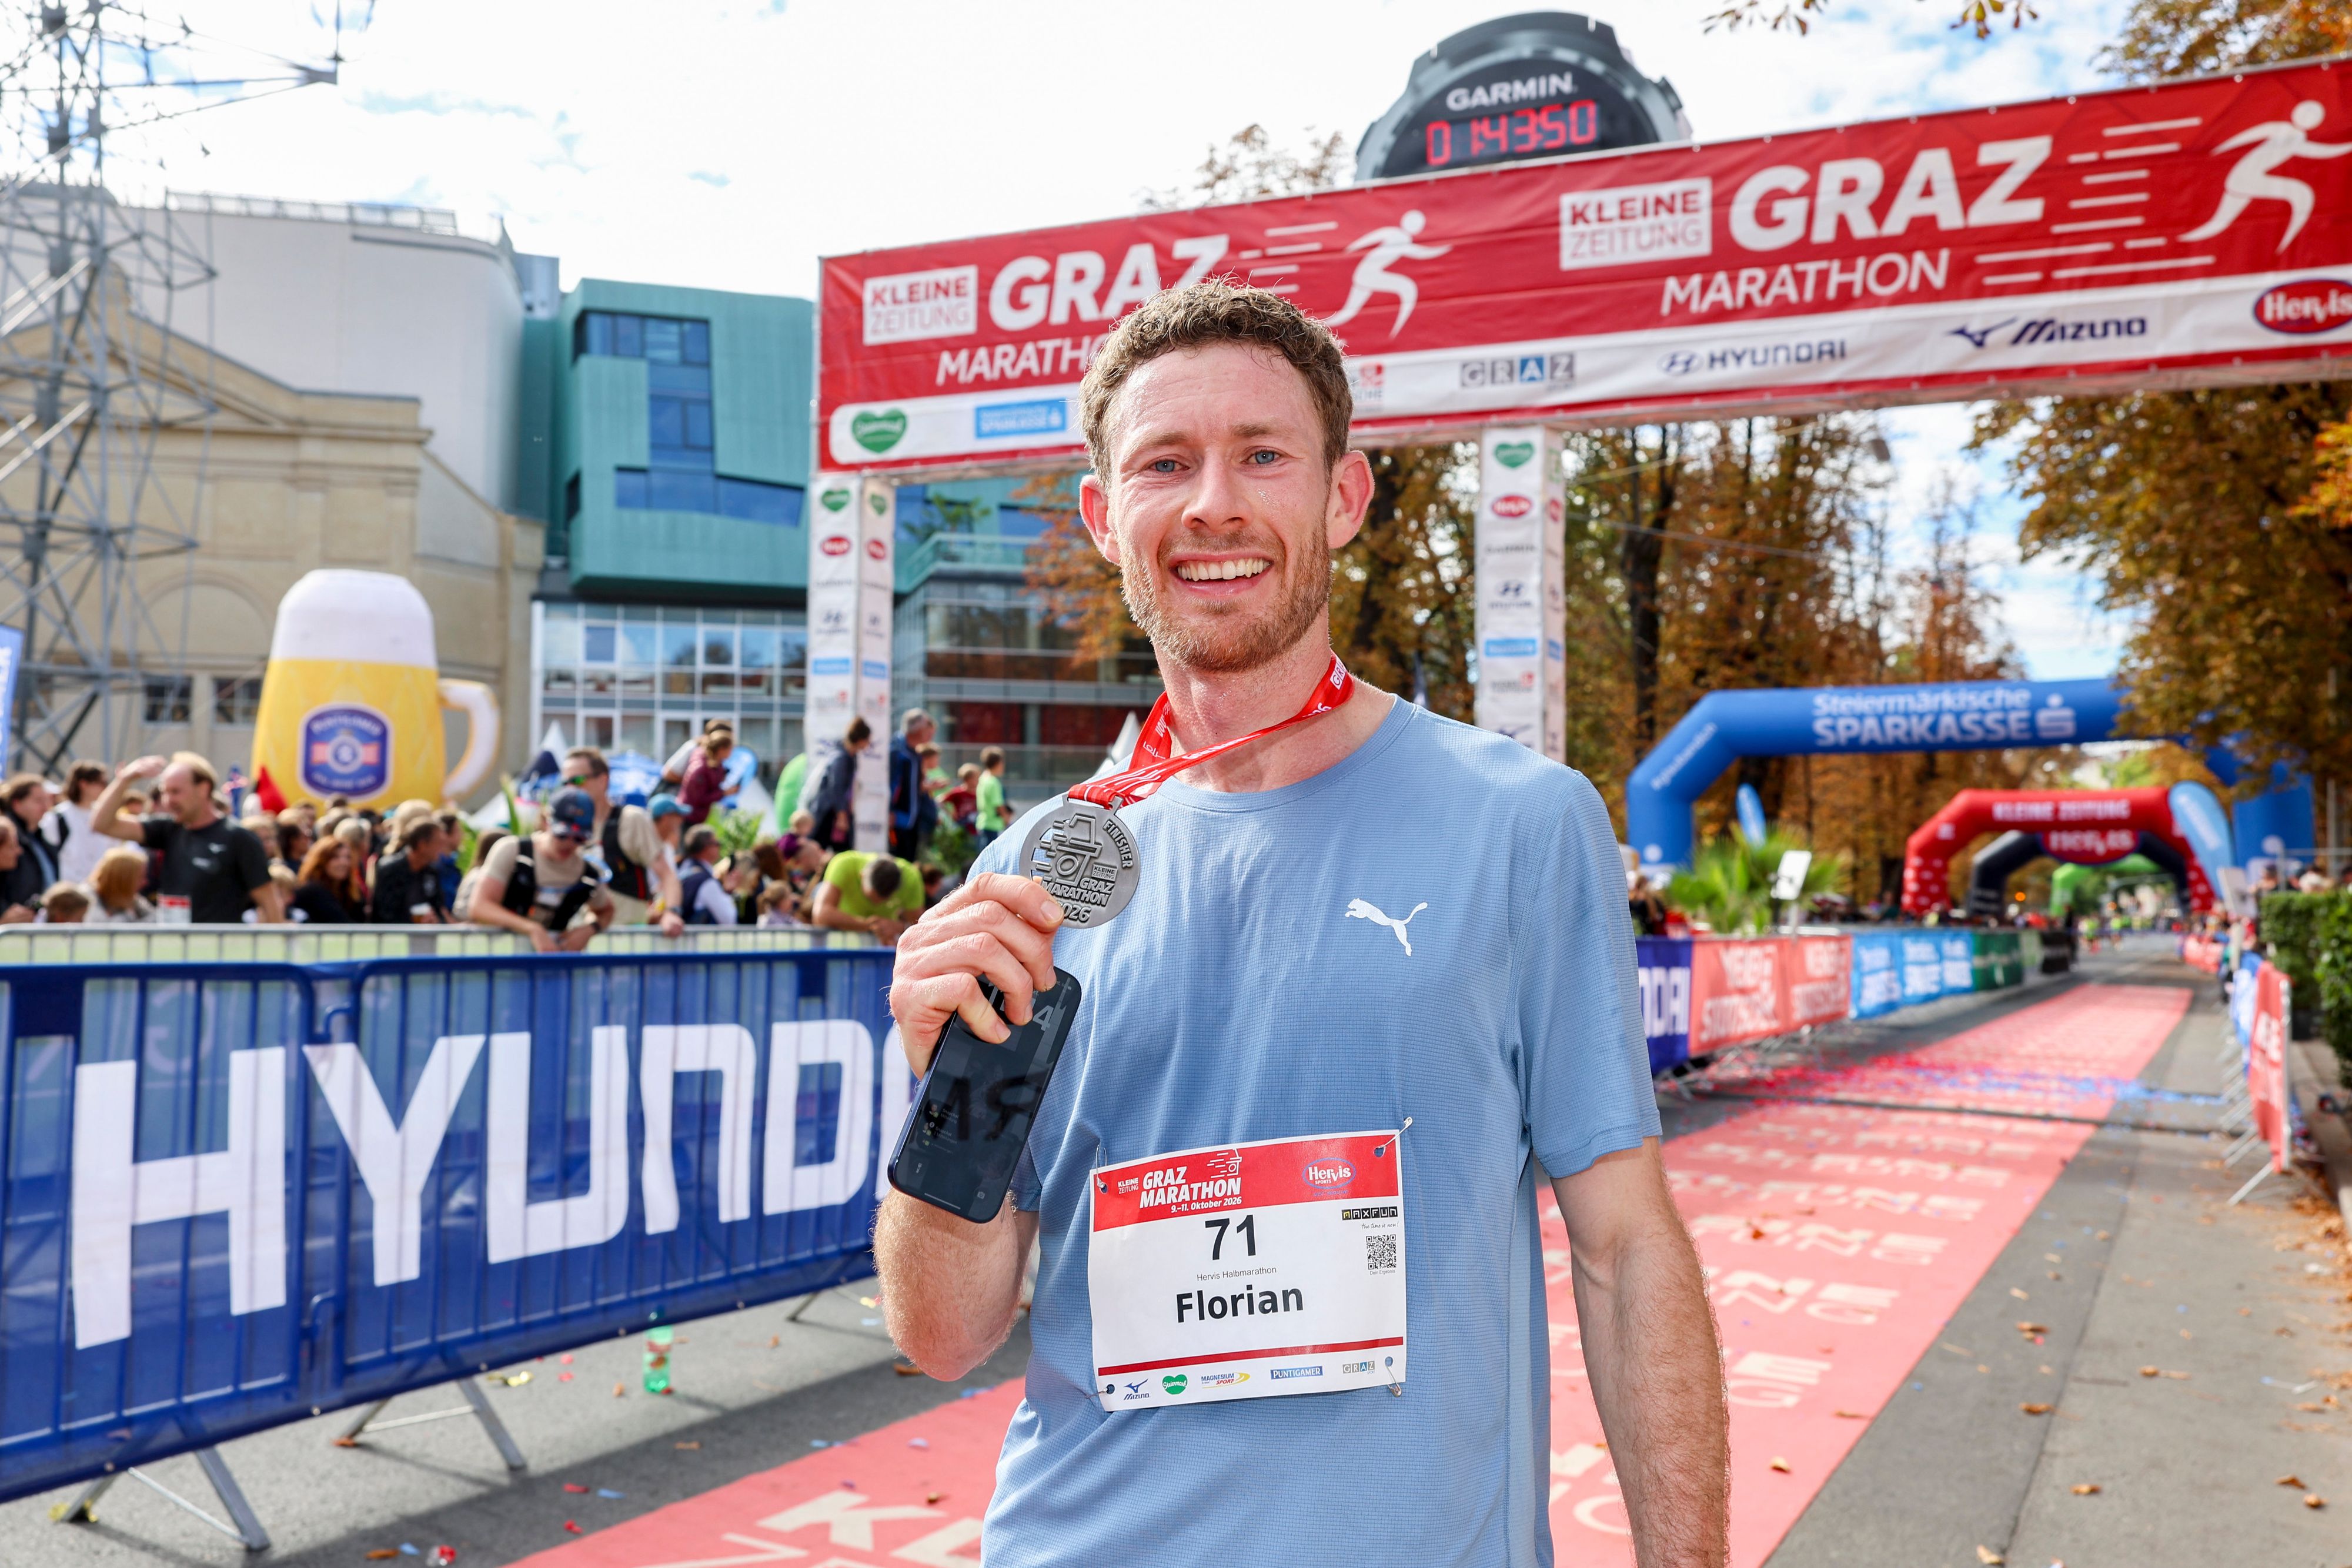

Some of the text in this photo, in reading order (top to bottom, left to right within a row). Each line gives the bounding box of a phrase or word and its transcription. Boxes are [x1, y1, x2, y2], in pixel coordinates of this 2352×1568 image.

[1446, 72, 1574, 112] GARMIN
[1571, 189, 1700, 226] KLEINE
[1729, 135, 2053, 252] GRAZ
[1569, 218, 1703, 259] ZEITUNG
[871, 276, 970, 306] KLEINE
[988, 233, 1230, 331] GRAZ
[1661, 248, 1950, 317] MARATHON
[870, 301, 970, 336] ZEITUNG
[2264, 288, 2352, 324] Hervis
[2010, 316, 2147, 346] MIZUNO
[936, 334, 1108, 386] MARATH
[1708, 339, 1847, 370] HYUNDAI
[1461, 354, 1575, 388] GRAZ
[1812, 687, 2032, 717] Steiermärkische
[1812, 710, 2032, 747] SPARKASSE
[1102, 820, 1133, 868] FINISHER
[1093, 871, 1115, 880] ZEITUNG
[1094, 865, 1115, 875] KLEINE
[1042, 881, 1110, 905] MARATHON
[1080, 877, 1115, 894] GRAZ
[1058, 901, 1092, 922] 026
[70, 1019, 914, 1350] HYUND
[1118, 1177, 1139, 1188] KLEINE
[1142, 1166, 1187, 1189] GRAZ
[1308, 1165, 1351, 1182] Hervis
[1118, 1183, 1139, 1195] ZEITUNG
[1140, 1177, 1241, 1209] MARATHON
[1191, 1199, 1222, 1211] Oktober
[1223, 1196, 1242, 1206] 2026
[1342, 1206, 1398, 1220] MAXFUN
[1205, 1215, 1256, 1261] 71
[1197, 1266, 1277, 1282] Hervis Halbmarathon
[1176, 1284, 1304, 1323] Florian
[1201, 1373, 1235, 1382] MAGNESIUM
[1272, 1367, 1321, 1379] PUNTIGAMER
[1342, 1360, 1375, 1374] GRAZ
[1162, 1379, 1187, 1390] Steiermark
